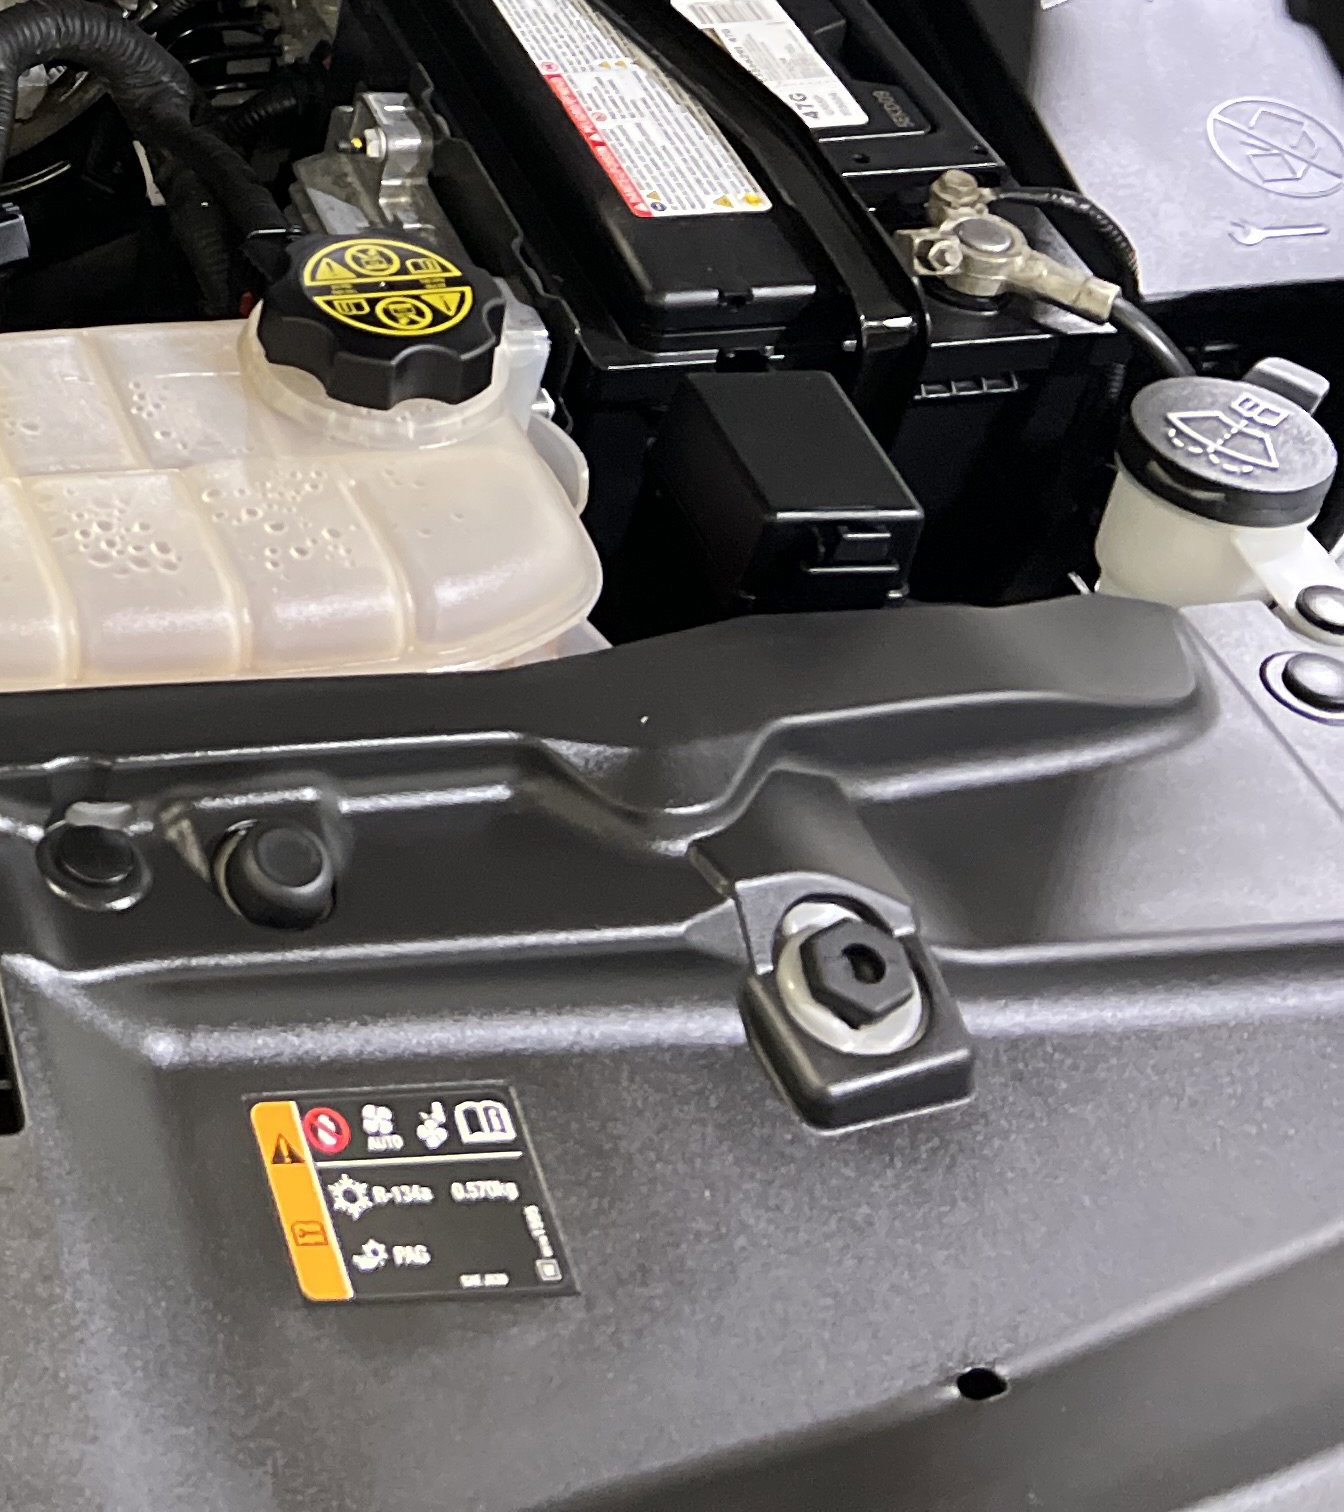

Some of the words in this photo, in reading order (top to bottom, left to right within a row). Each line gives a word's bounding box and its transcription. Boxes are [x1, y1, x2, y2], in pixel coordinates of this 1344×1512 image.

[367, 1134, 404, 1152] AUTO
[371, 1184, 434, 1205] R-134a
[450, 1180, 520, 1202] 0.570kg
